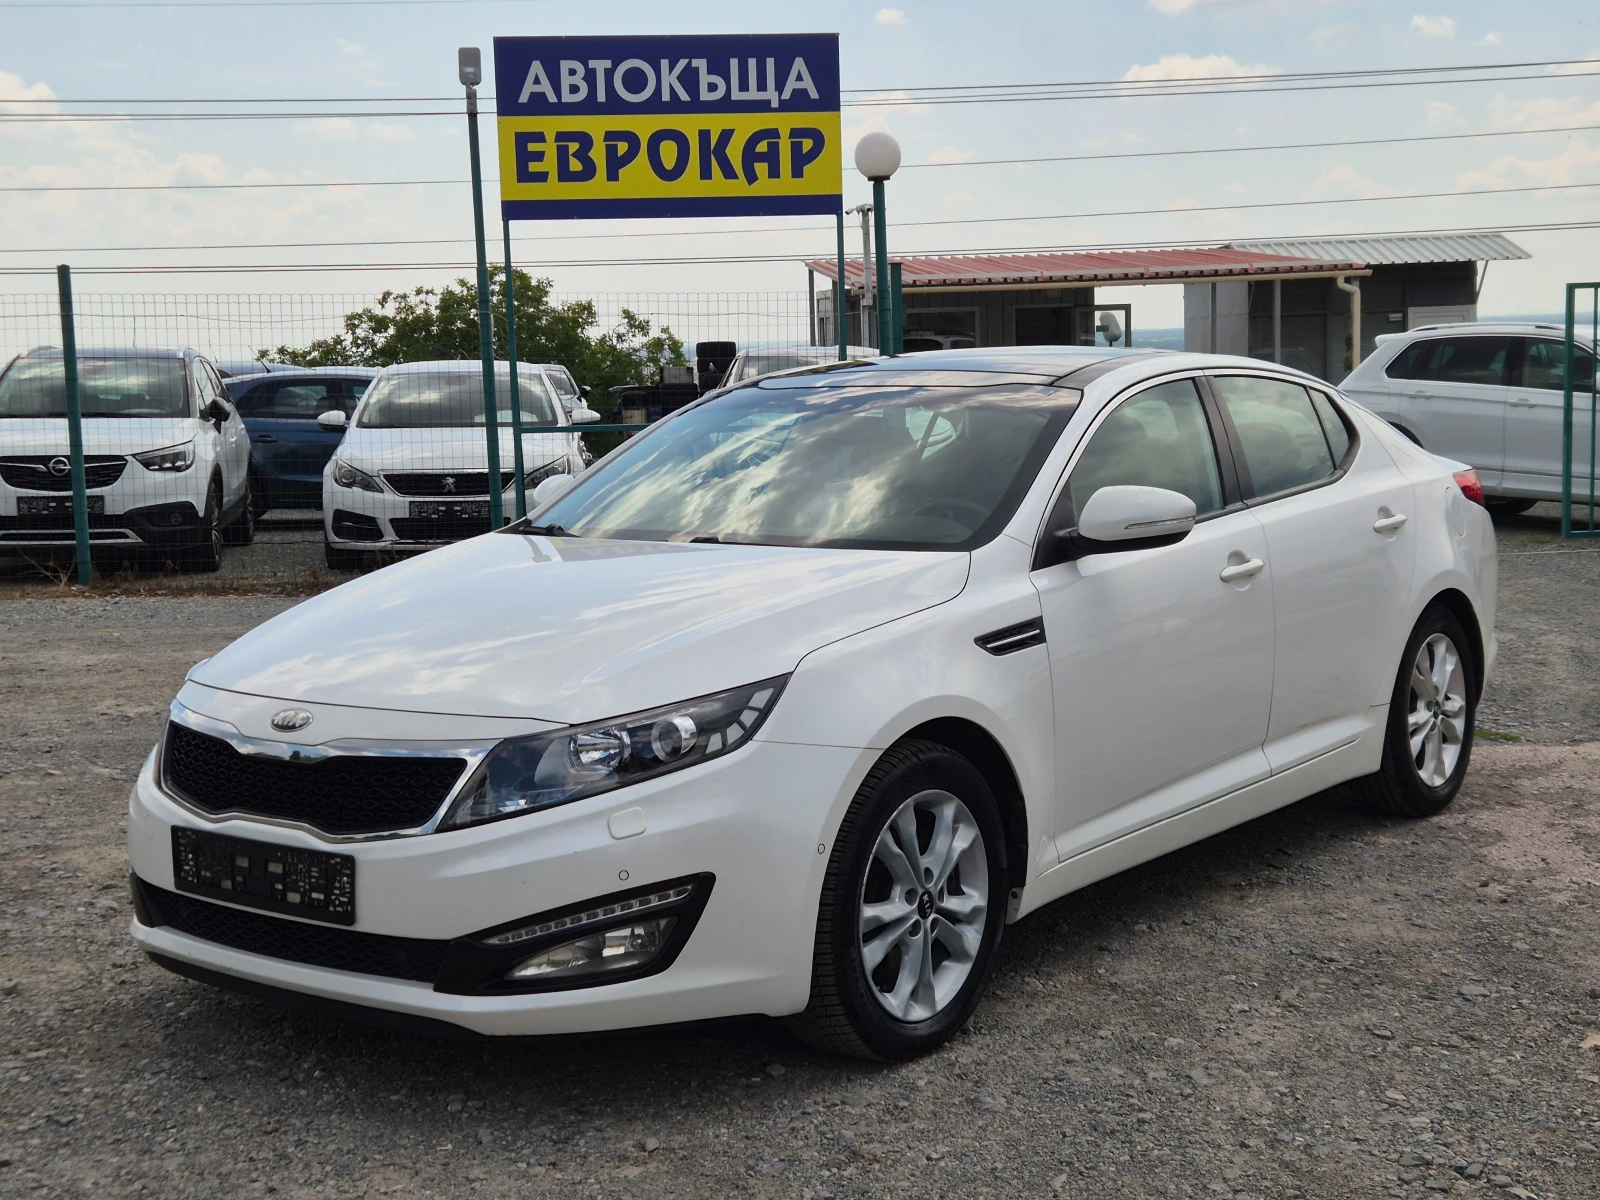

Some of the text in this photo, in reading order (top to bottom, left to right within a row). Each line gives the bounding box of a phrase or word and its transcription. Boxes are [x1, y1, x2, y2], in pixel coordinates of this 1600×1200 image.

[518, 57, 820, 108] АВТОКЪЩА
[514, 127, 826, 187] ЕВРОКАР
[273, 710, 311, 728] KIA
